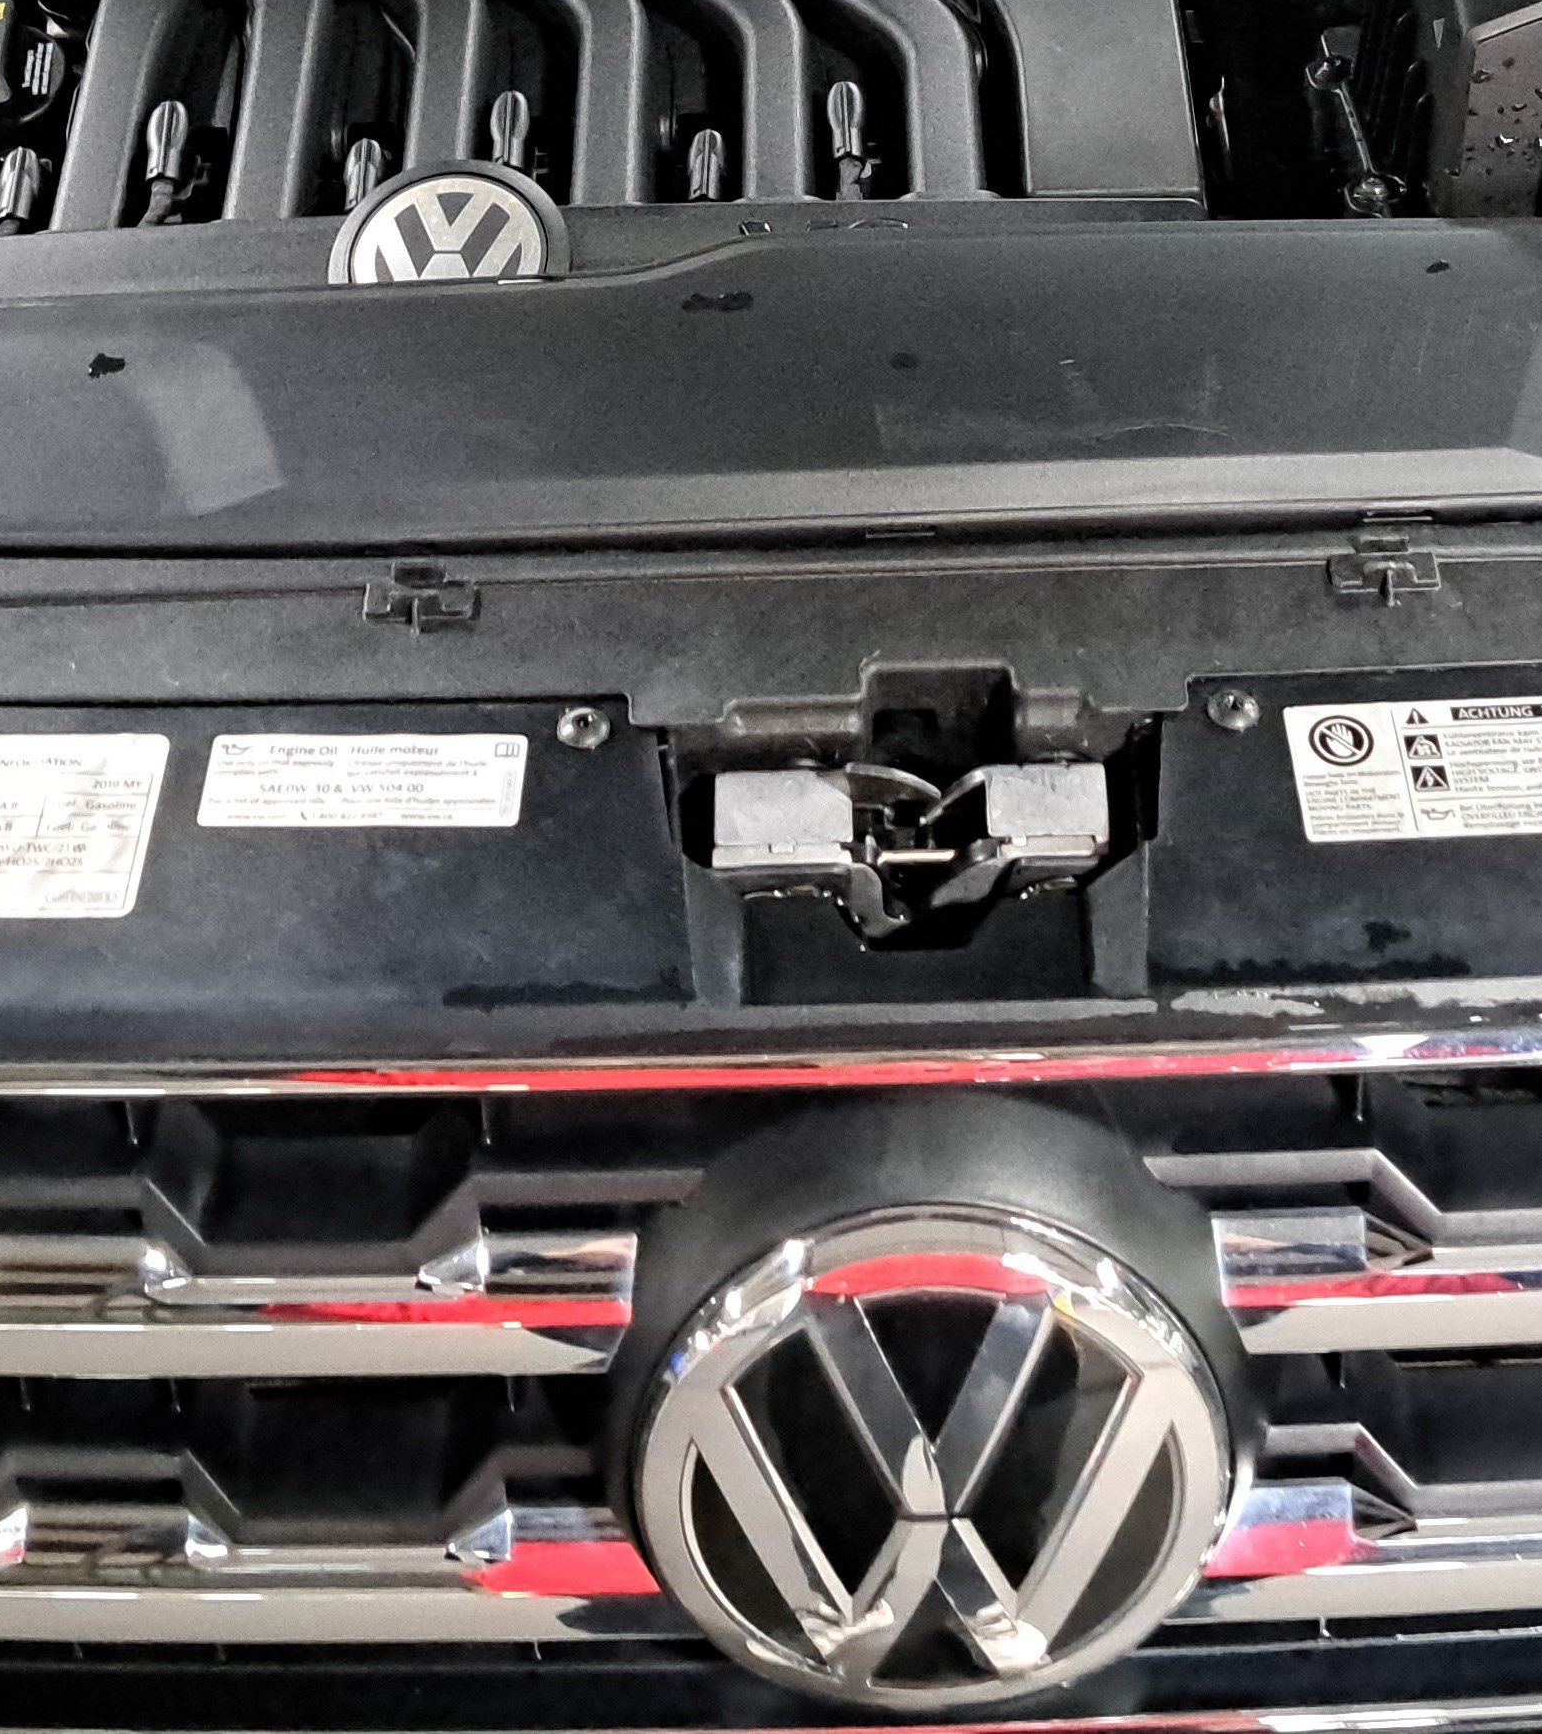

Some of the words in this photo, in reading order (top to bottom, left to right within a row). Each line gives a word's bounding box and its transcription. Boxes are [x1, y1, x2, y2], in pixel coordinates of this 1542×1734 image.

[1458, 706, 1534, 719] ACHTUNG
[270, 745, 315, 757] Engine
[318, 746, 338, 756] Oil
[351, 745, 385, 755] Huile
[389, 745, 439, 756] moteur
[351, 783, 374, 794] VW
[85, 800, 138, 811] Gasoline
